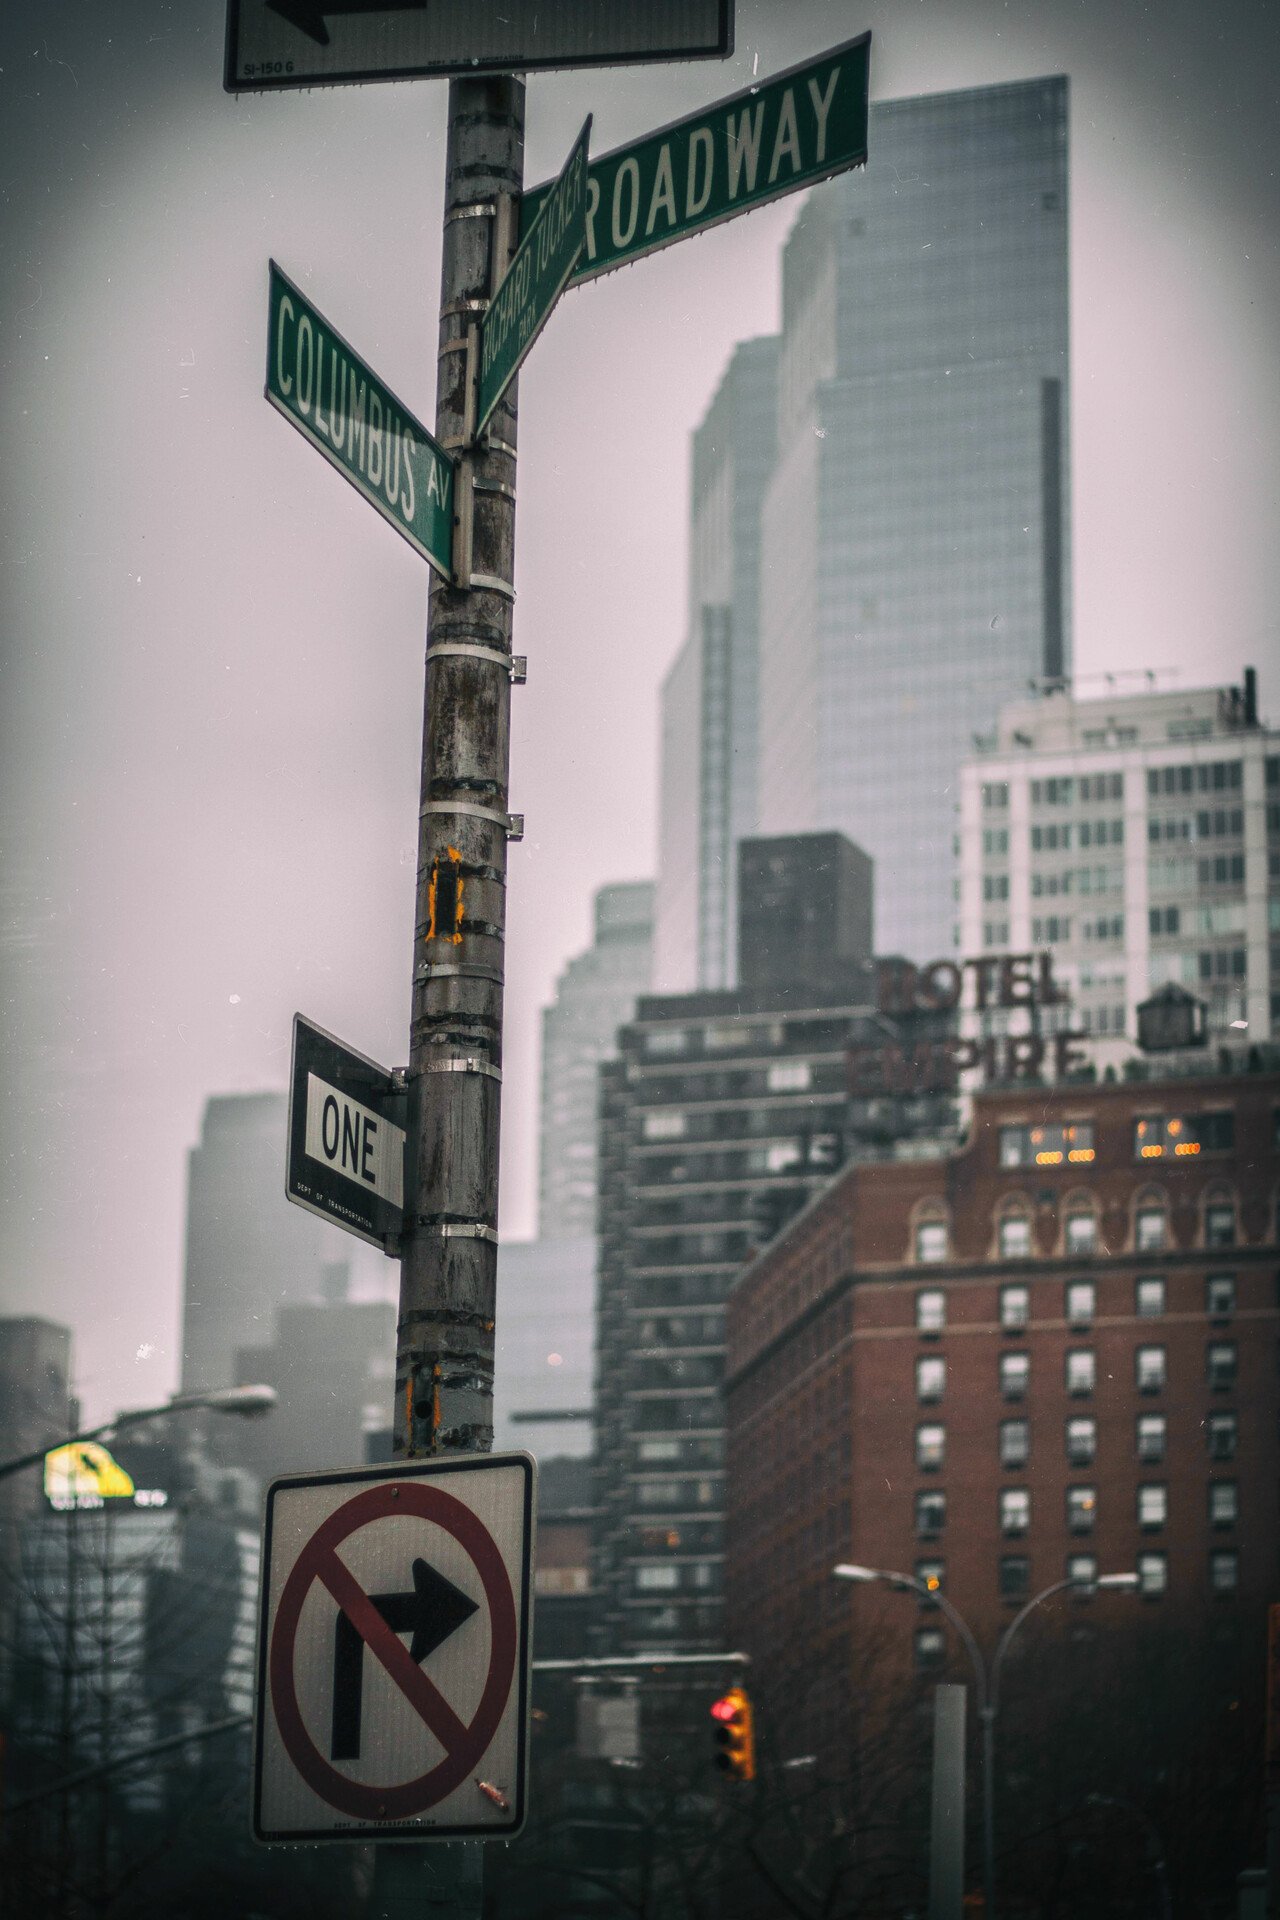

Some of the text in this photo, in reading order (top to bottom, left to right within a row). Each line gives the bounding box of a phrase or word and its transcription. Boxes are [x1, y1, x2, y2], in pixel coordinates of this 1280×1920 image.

[540, 67, 842, 260] ROADWAY
[482, 145, 583, 382] RICHARD TUCKER
[277, 294, 450, 523] COLUMBUS AV
[872, 951, 1071, 1012] HOTEL
[322, 1094, 377, 1185] ONE
[297, 1182, 373, 1229] DEPT OF TRANSPORTATION
[374, 1820, 436, 1828] TRANSPORTATION
